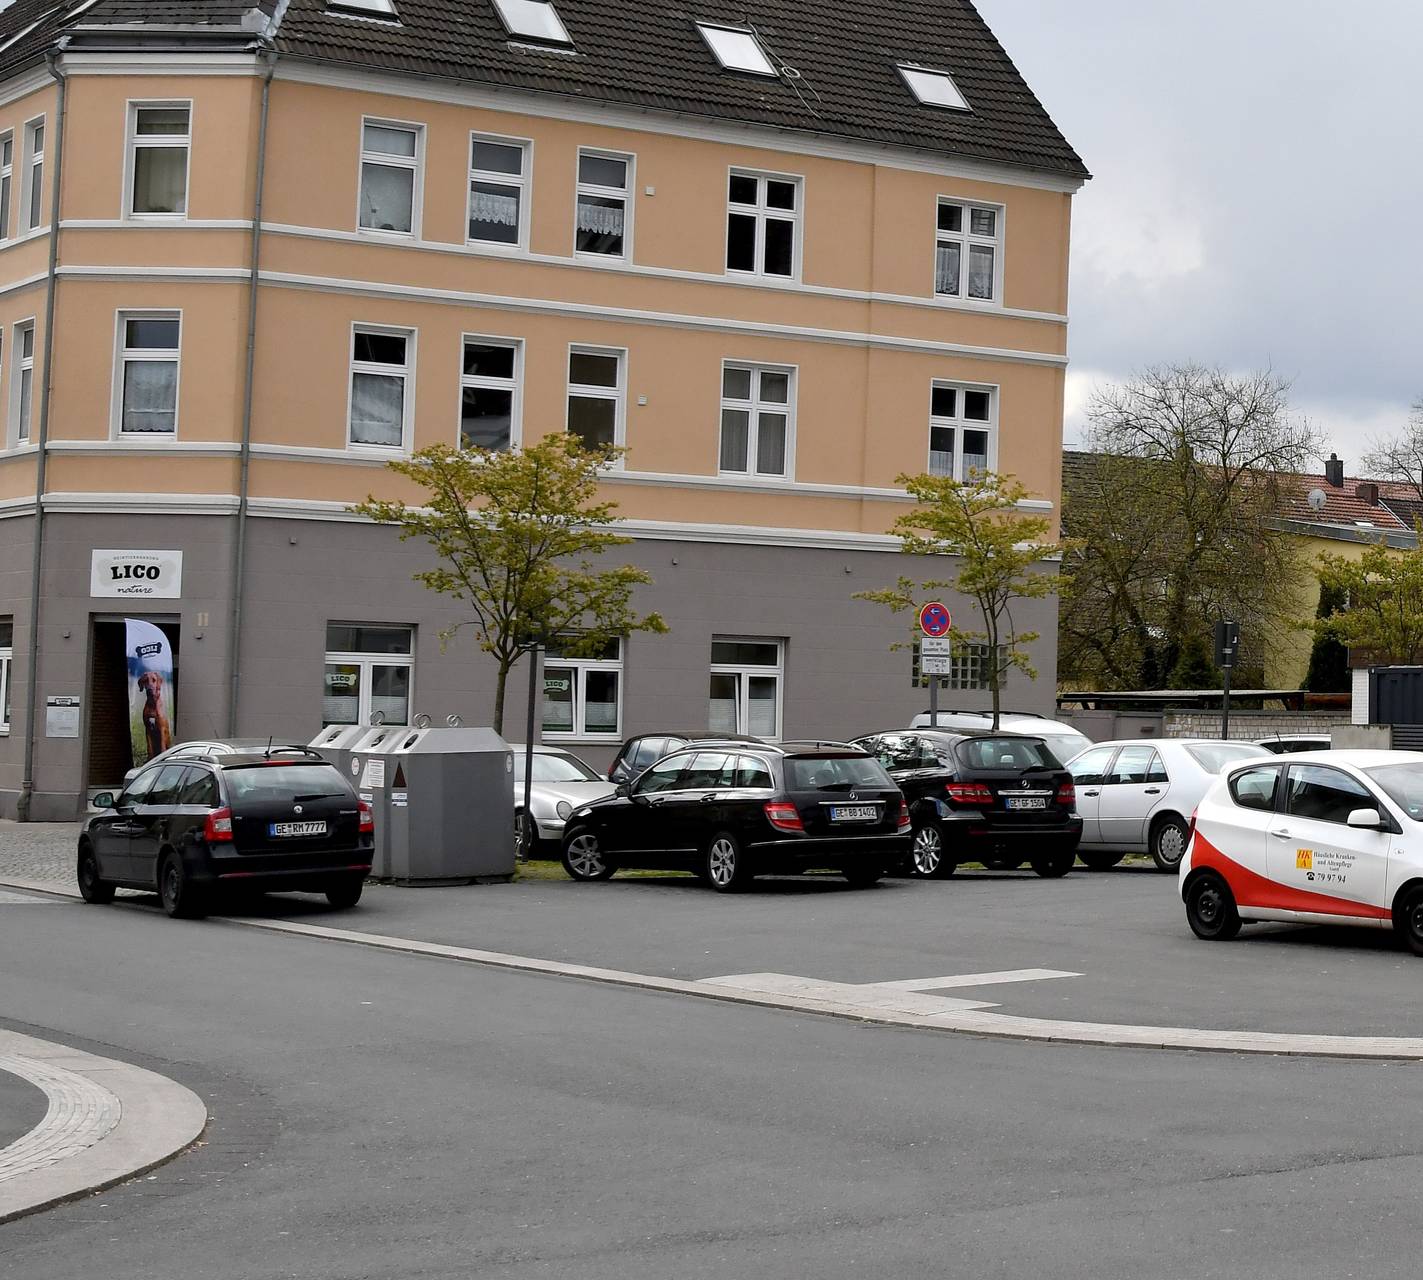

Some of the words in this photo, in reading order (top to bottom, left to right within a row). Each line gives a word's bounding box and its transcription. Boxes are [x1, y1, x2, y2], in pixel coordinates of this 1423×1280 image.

[111, 565, 160, 580] LICO
[117, 585, 153, 593] nature
[1010, 800, 1018, 808] GE
[836, 809, 844, 818] GE
[859, 808, 876, 817] 1402
[277, 825, 286, 834] GE
[293, 824, 304, 833] RM
[305, 823, 325, 832] 7777
[1318, 873, 1326, 881] 79
[1328, 874, 1336, 882] 97
[1338, 875, 1346, 884] 94
